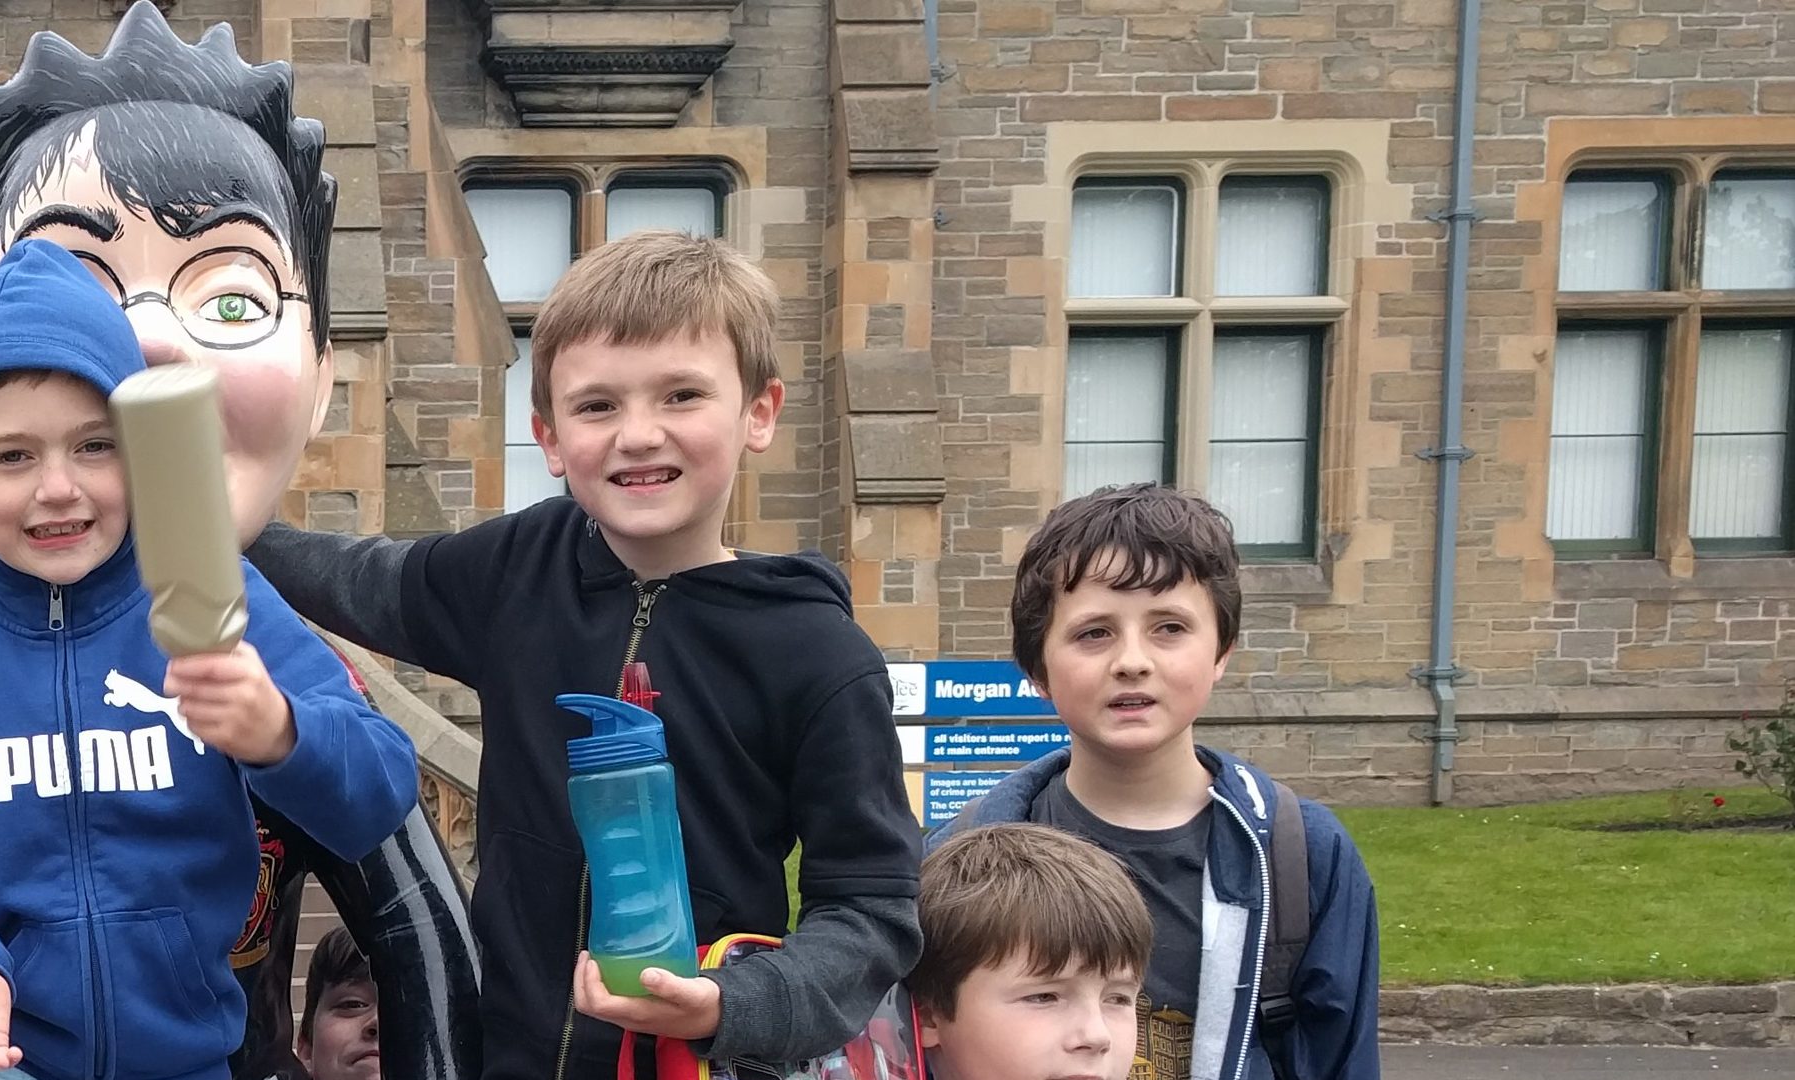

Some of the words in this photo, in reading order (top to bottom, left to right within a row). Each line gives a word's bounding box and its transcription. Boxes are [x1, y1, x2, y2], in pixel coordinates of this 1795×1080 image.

[935, 678, 1011, 702] Morgan
[933, 733, 948, 744] all
[949, 733, 988, 744] visitors
[989, 733, 1016, 744] must
[1017, 733, 1050, 746] report
[1050, 732, 1063, 744] to
[933, 746, 945, 756] at
[947, 745, 973, 756] main
[974, 745, 1020, 756] entrance
[930, 778, 962, 788] Images
[962, 779, 977, 787] are
[930, 788, 940, 797] of
[940, 788, 966, 797] crime
[930, 801, 947, 810] The
[948, 801, 967, 810] CCT
